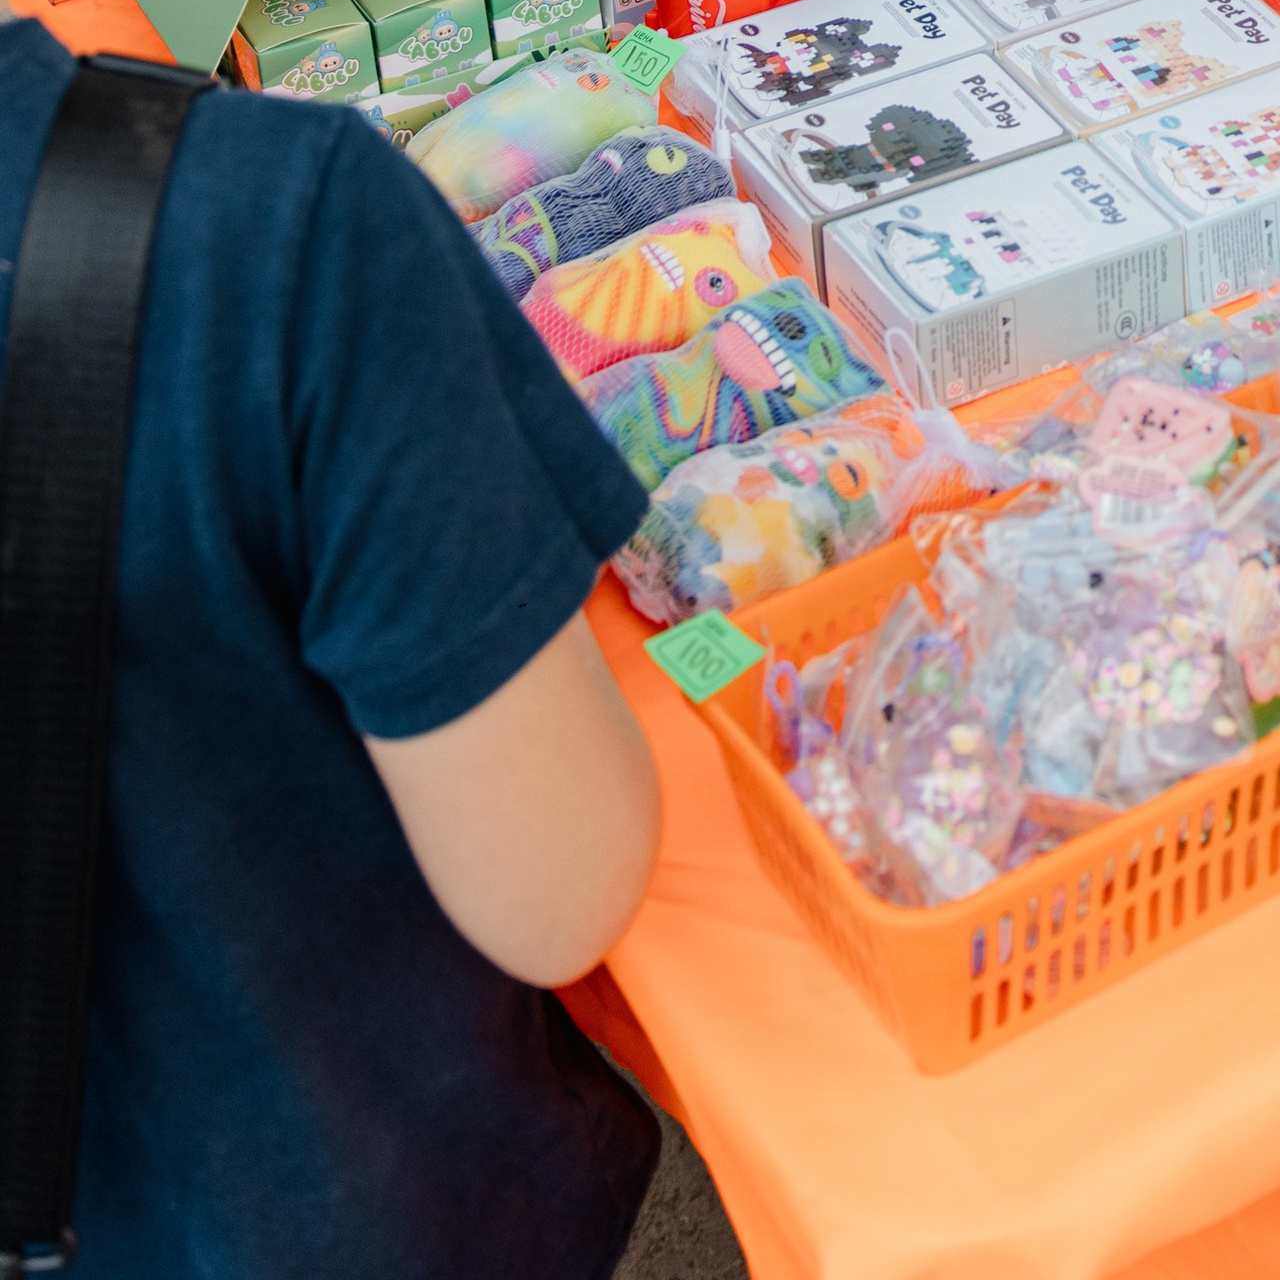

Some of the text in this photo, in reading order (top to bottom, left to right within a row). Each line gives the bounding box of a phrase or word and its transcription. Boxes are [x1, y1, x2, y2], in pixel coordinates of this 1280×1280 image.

[634, 30, 654, 44] ЦЕНА
[913, 12, 947, 39] Day
[1234, 16, 1271, 44] Day
[398, 26, 474, 62] LABUBU
[621, 45, 658, 77] 150
[281, 58, 360, 96] LABUBU
[960, 74, 1000, 101] Pet
[985, 100, 1021, 129] Day
[1060, 165, 1102, 194] Pet
[1089, 192, 1128, 224] Day
[678, 636, 726, 680] 100
